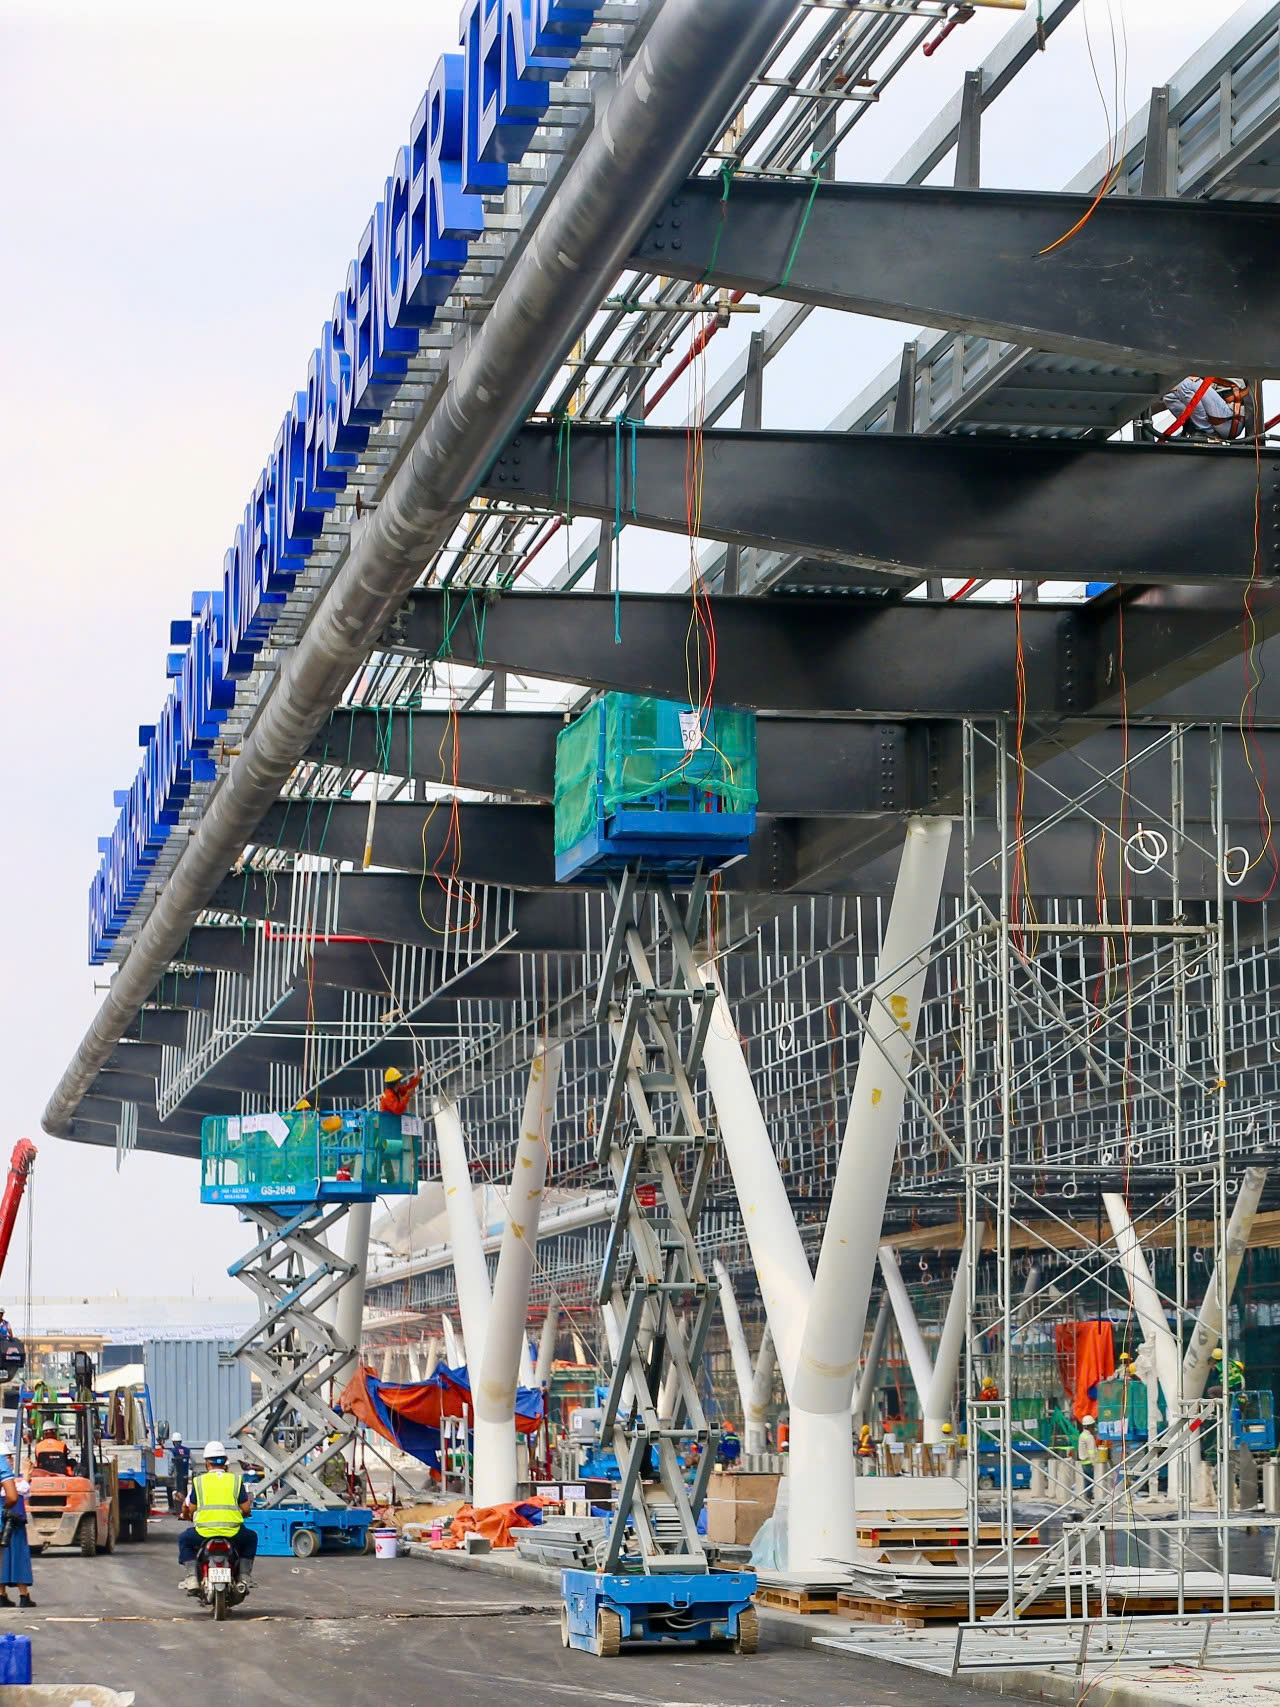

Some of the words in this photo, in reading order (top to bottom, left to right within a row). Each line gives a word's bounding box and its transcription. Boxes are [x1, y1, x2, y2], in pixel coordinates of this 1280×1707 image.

[222, 391, 314, 681] DOMESTIC
[303, 53, 465, 512] PASSENGER
[683, 730, 696, 741] 50
